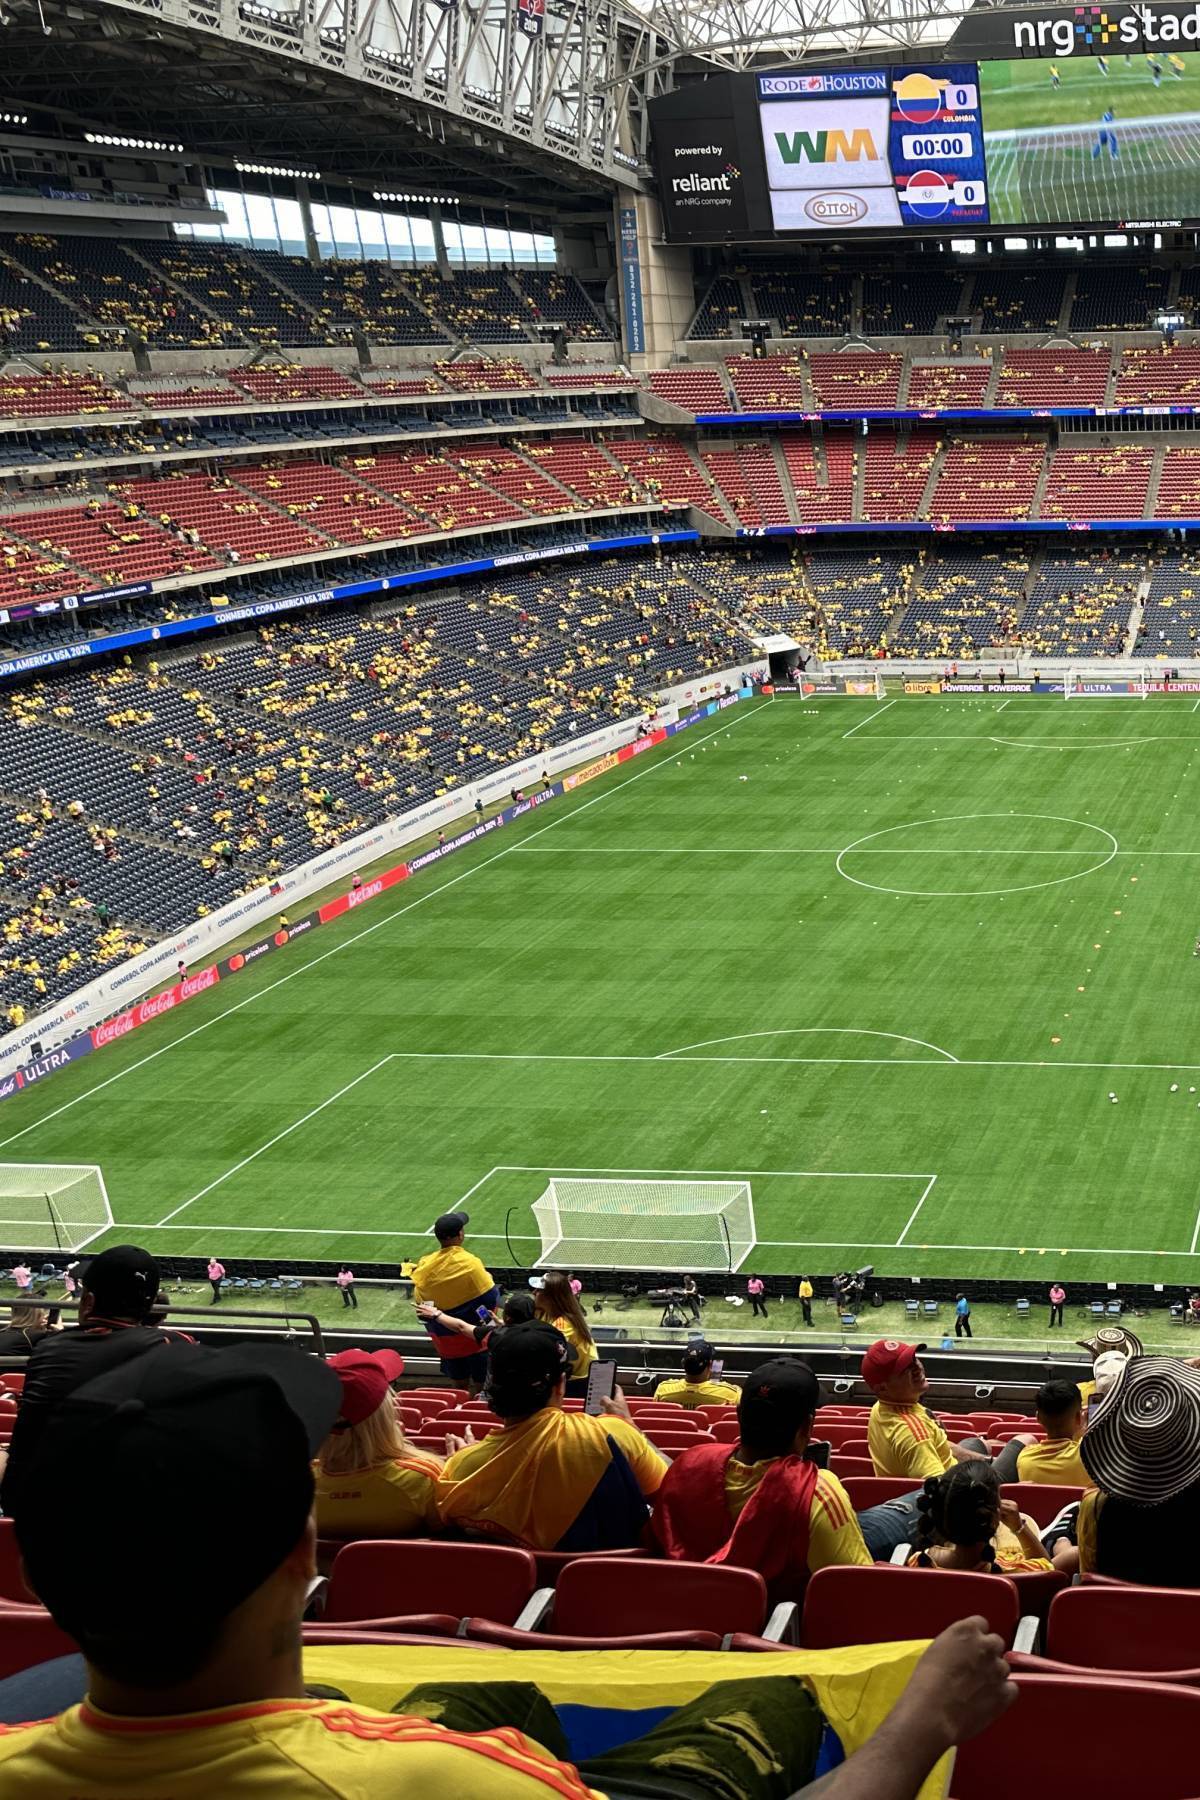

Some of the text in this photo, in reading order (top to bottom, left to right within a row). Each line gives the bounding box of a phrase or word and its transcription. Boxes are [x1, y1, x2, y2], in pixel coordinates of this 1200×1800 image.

[1013, 19, 1074, 56] nrg
[956, 90, 967, 106] 0
[942, 114, 976, 122] COLOMBIA
[674, 146, 723, 157] powered by
[774, 129, 879, 164] WM
[912, 138, 964, 156] 00:00
[672, 173, 730, 192] reliant
[686, 198, 700, 206] NRG
[701, 198, 732, 208] company
[963, 186, 975, 202] 0
[812, 200, 858, 218] COTTON
[215, 590, 334, 623] CONMEBOL COPA AMERICA USA 2024
[16, 653, 52, 671] AMERICA
[54, 650, 72, 662] USA
[71, 644, 92, 659] 2024
[1133, 684, 1165, 692] TEQUILA
[535, 788, 555, 804] ULTRA
[336, 852, 348, 864] COPA
[347, 844, 366, 858] AMERICA
[412, 850, 442, 871] CONMEBOL
[441, 843, 456, 856] COPA
[454, 828, 476, 847] AMERICA
[217, 893, 276, 929] CONMEBOL COPA AMERIC
[110, 934, 200, 991] CONMEBOL COPA AMERICA USA 2024
[244, 944, 269, 962] priceless
[21, 1032, 38, 1048] COPA
[38, 1016, 64, 1038] AMERICA
[64, 1008, 76, 1020] USA
[74, 1000, 90, 1014] 2024
[25, 1050, 72, 1082] ULTRA
